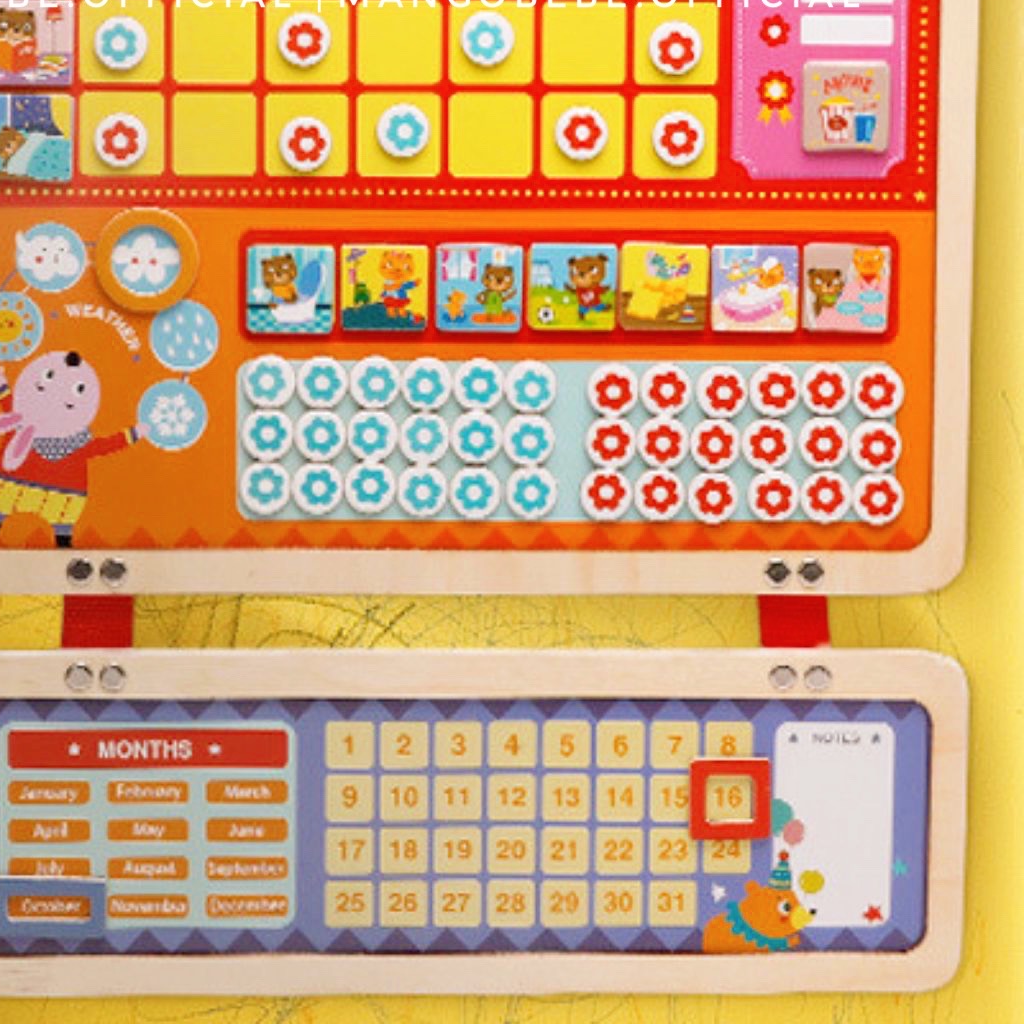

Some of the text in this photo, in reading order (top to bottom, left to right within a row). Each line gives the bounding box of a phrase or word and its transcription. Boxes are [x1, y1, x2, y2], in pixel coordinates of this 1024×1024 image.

[65, 303, 142, 351] WEATHER
[343, 733, 736, 757] 1 2 3 4 5 6 7 8
[811, 733, 861, 745] NOTES
[97, 739, 194, 760] MONTHS
[19, 785, 78, 802] January
[116, 783, 183, 800] February
[224, 785, 272, 799] March
[341, 785, 742, 809] 9 10 11 12 13 14 15 16
[33, 823, 69, 839] April
[132, 823, 166, 838] May
[228, 823, 265, 837] June
[337, 839, 741, 861] 17 18 19 20 21 22 23 24
[36, 860, 65, 875] July
[123, 861, 177, 877] August
[21, 898, 83, 913] October
[336, 892, 685, 913] 25 26 27 28 29 30 31
